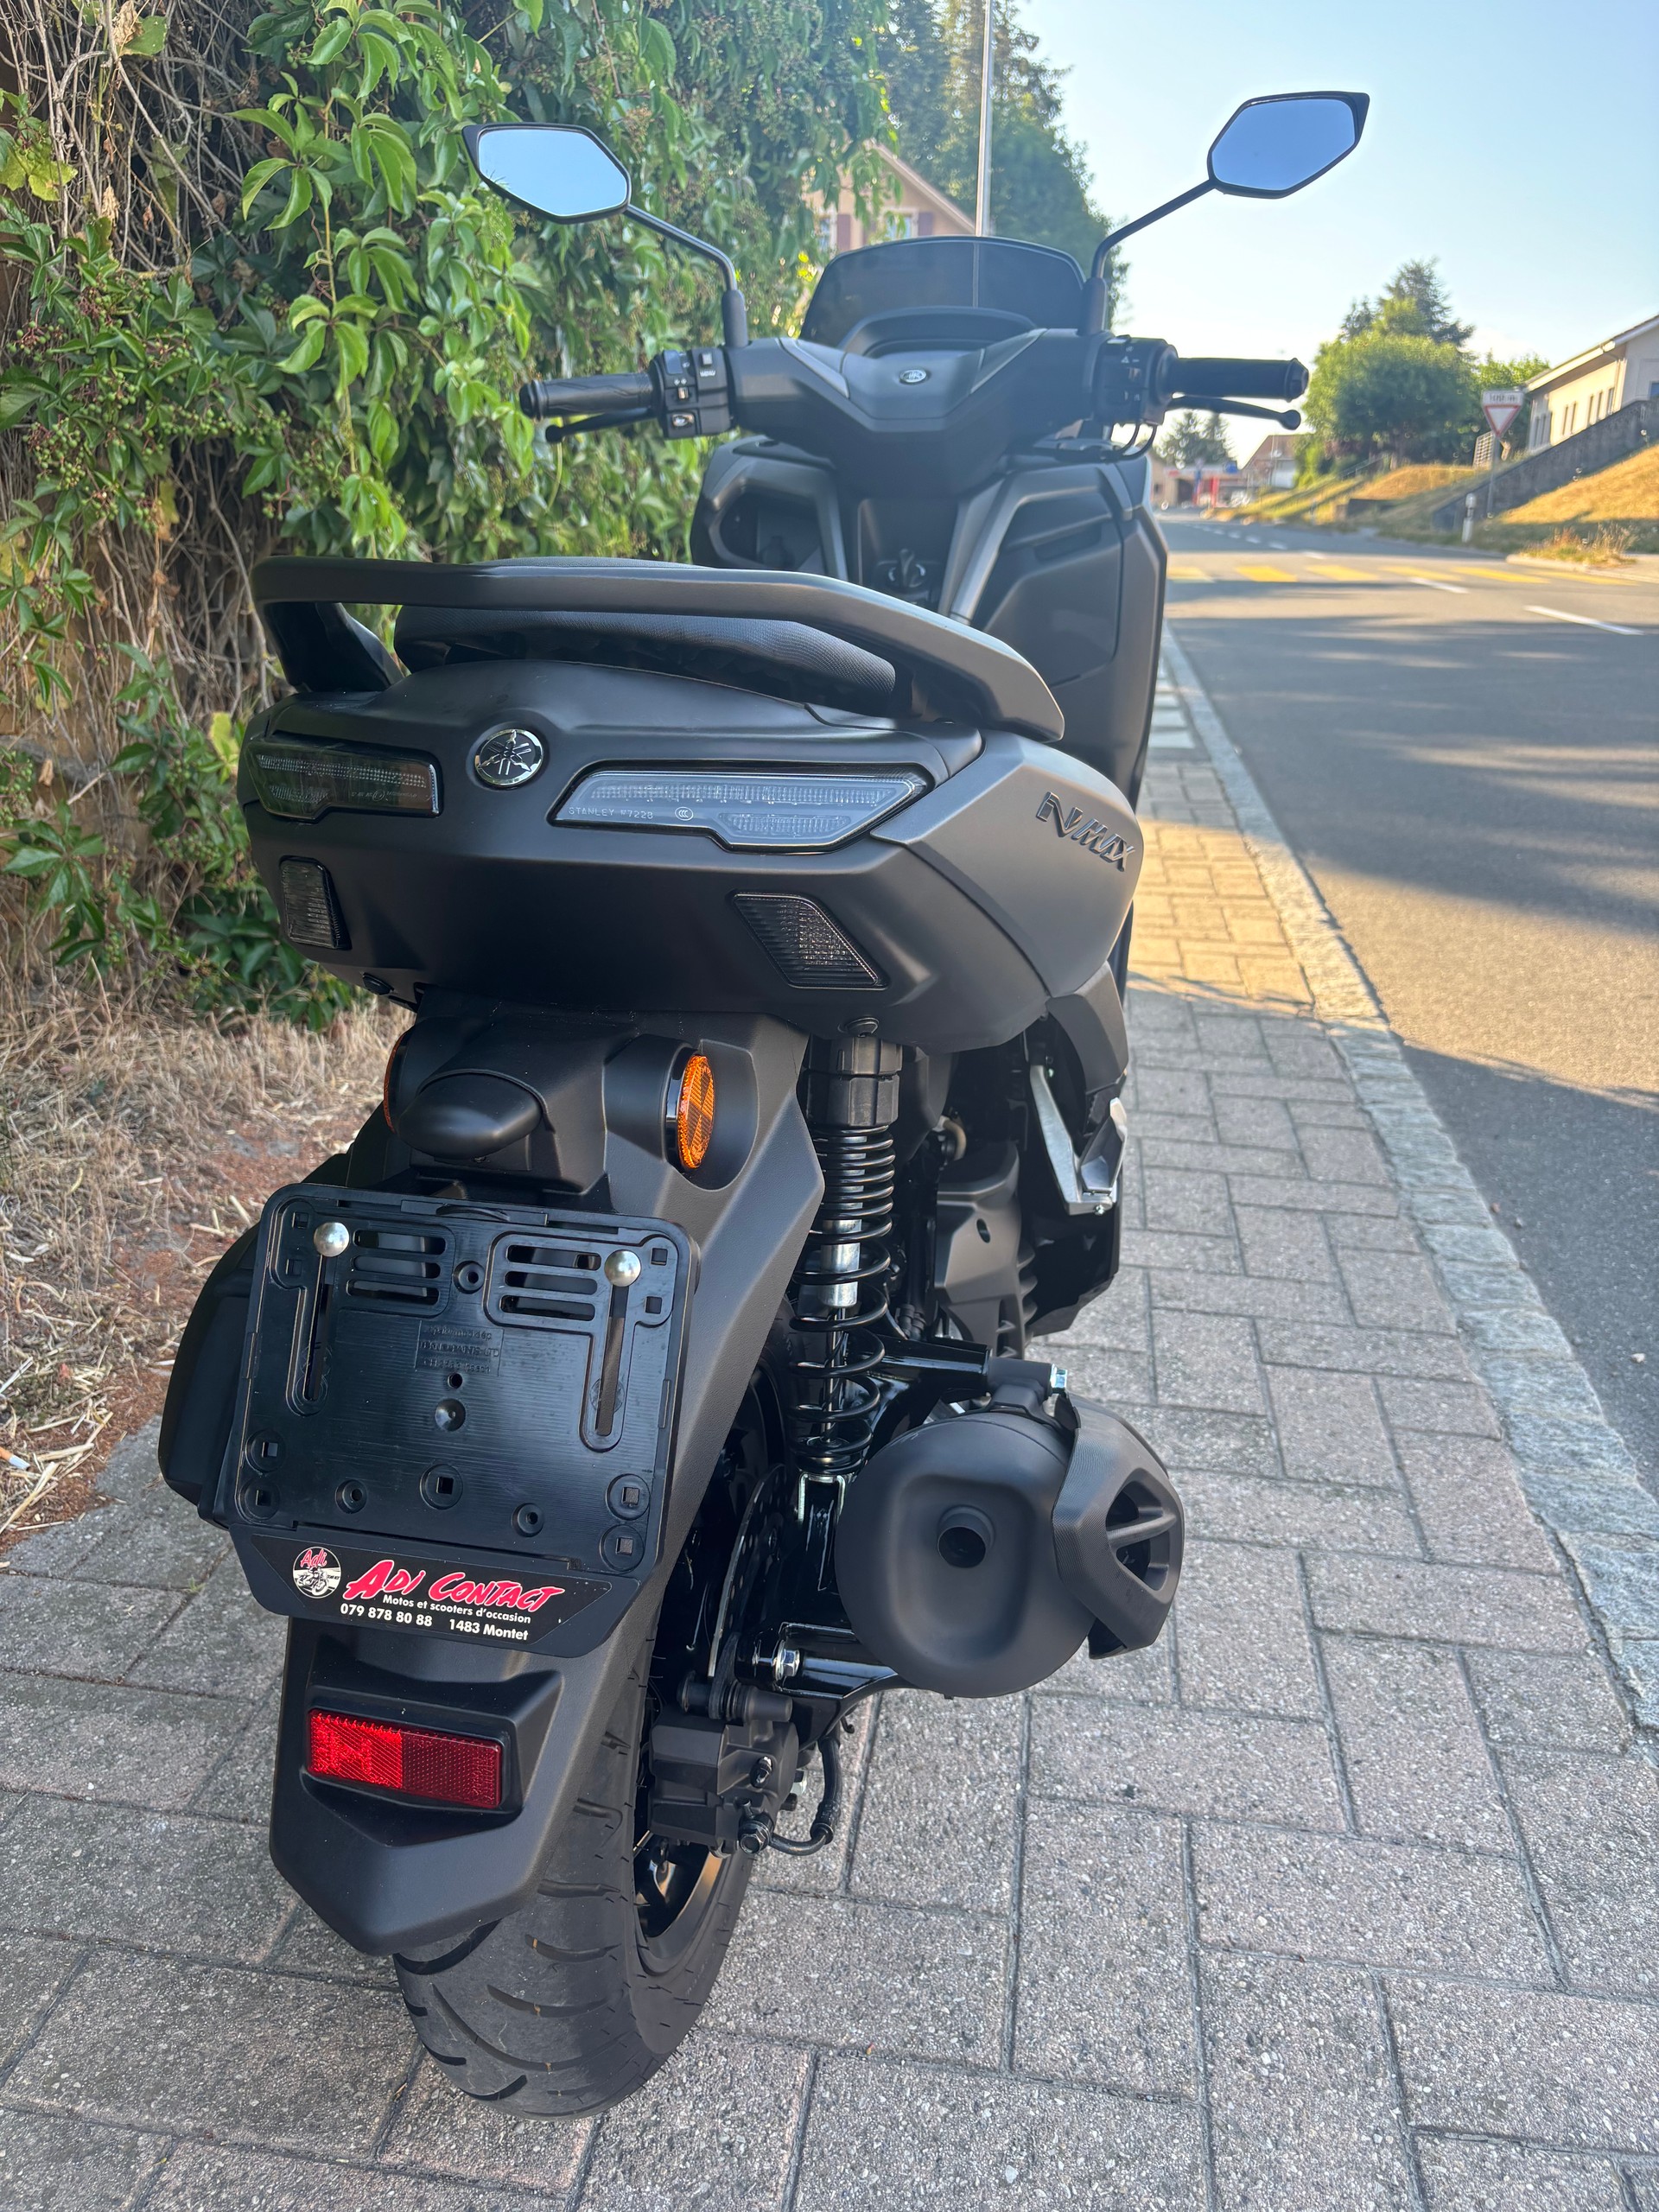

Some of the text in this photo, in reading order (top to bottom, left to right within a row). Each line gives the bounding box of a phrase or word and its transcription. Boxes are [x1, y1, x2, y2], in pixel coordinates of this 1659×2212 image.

[569, 807, 614, 817] STANLEY
[1036, 791, 1135, 872] NMAX
[300, 1548, 327, 1568] Adi
[383, 1594, 414, 1607] Motos
[416, 1600, 428, 1610] et
[429, 1603, 473, 1616] scooters
[340, 1603, 529, 1641] 079 878 80 88 1483 Montet
